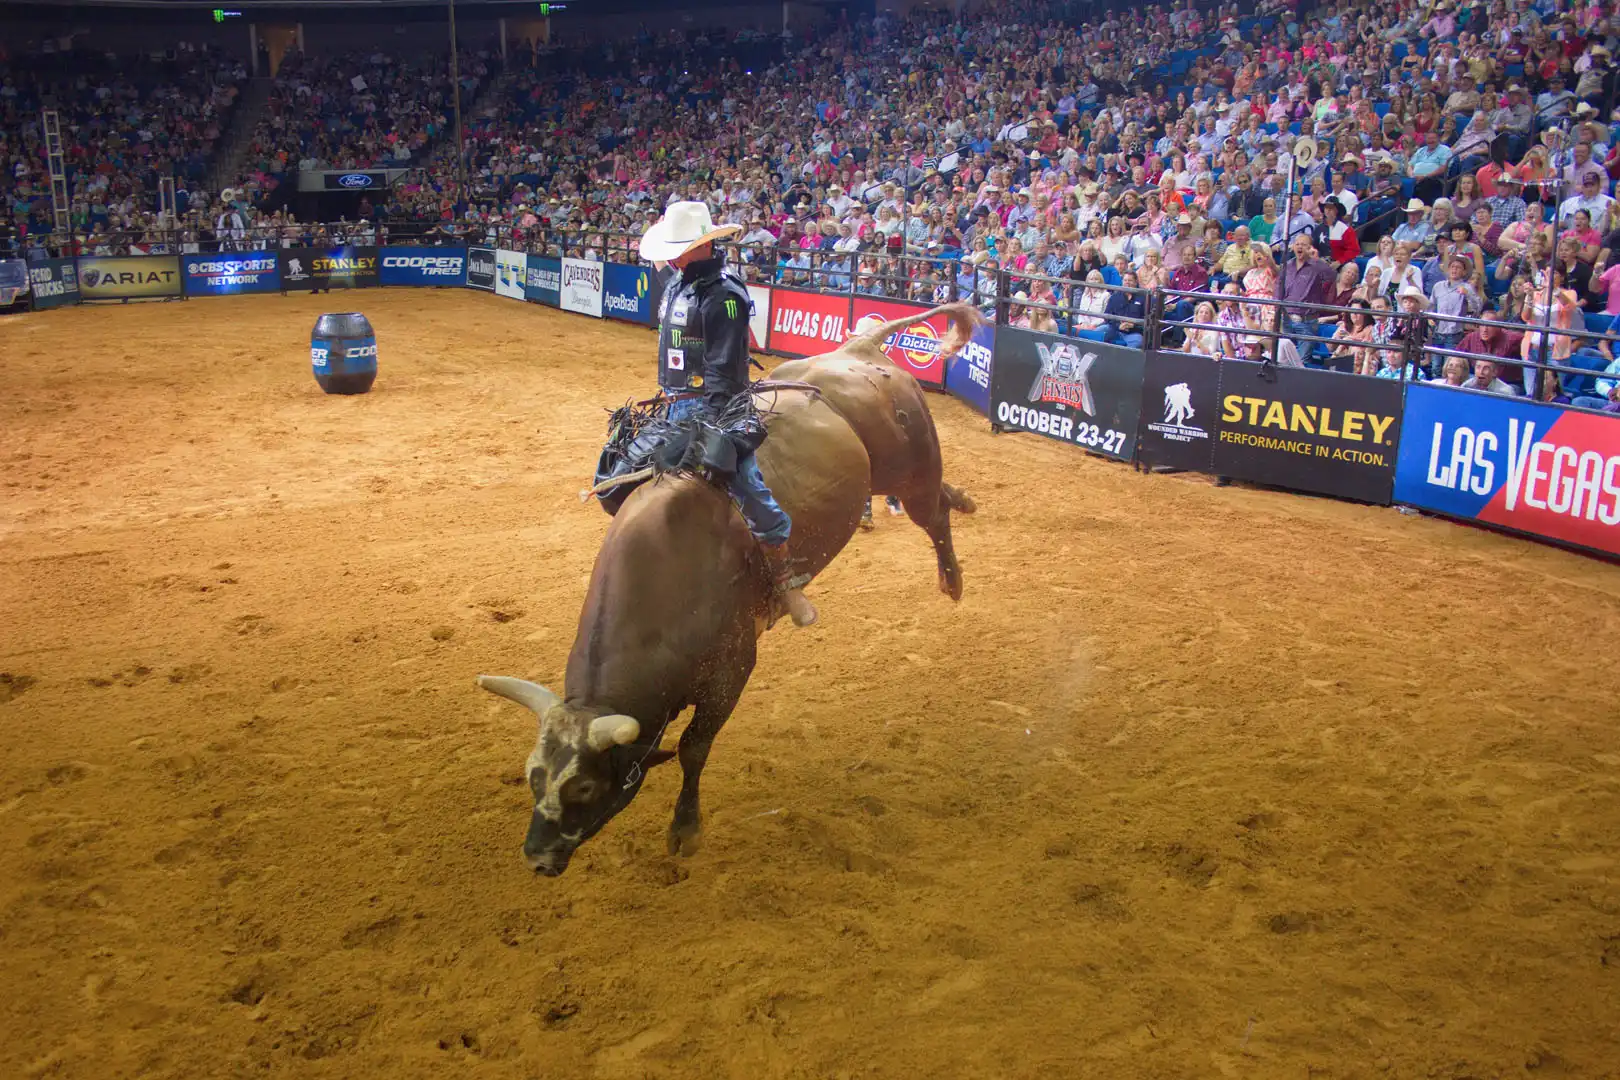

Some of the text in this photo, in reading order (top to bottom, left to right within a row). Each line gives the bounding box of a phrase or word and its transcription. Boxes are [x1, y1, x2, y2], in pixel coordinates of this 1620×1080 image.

[312, 257, 376, 270] STANLEY
[383, 256, 464, 268] COOPER
[420, 267, 462, 276] TIRES
[30, 267, 53, 284] FORD
[101, 270, 176, 285] ARIAT
[207, 275, 259, 286] NETWORK
[564, 264, 601, 292] CAVENDER'S
[32, 280, 65, 298] TRUCKS
[604, 290, 639, 313] ApexBrasil
[773, 307, 820, 338] LUCAS
[821, 314, 844, 343] OIL
[968, 363, 990, 389] TIRES
[997, 401, 1126, 455] OCTOBER 23-27
[1221, 394, 1395, 445] STANLEY
[1163, 432, 1191, 442] PROJECT
[1219, 431, 1312, 455] PERFORMANCE
[1315, 445, 1329, 458] IN
[1426, 418, 1620, 526] LAS VEGAS
